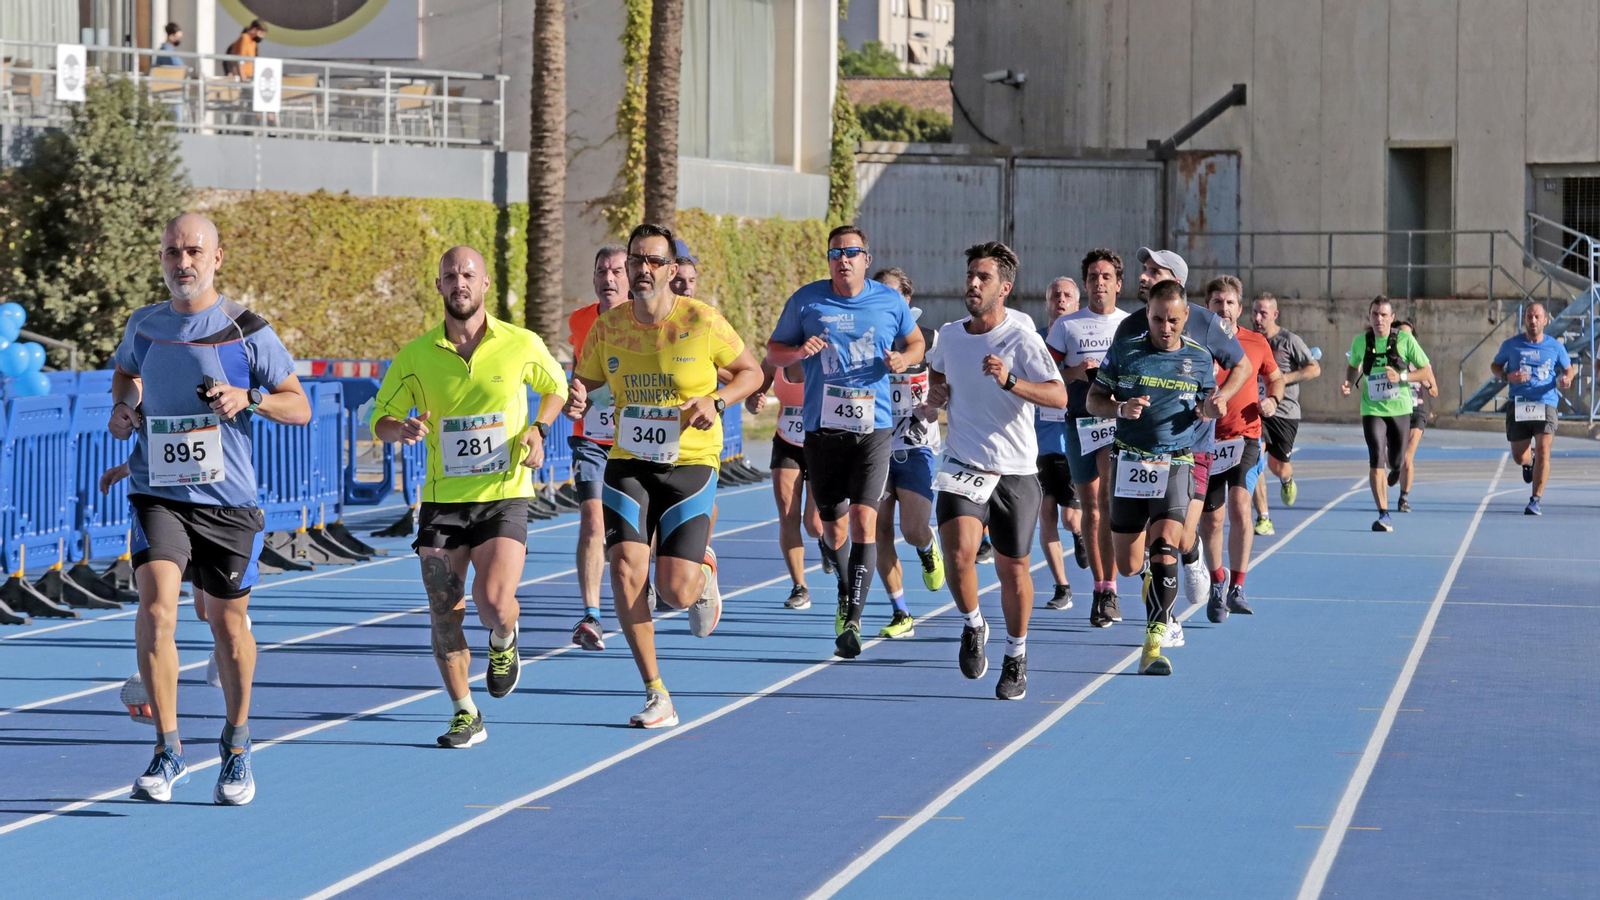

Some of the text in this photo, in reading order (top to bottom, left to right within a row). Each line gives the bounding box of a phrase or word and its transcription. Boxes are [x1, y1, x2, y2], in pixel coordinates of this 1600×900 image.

[837, 313, 854, 321] XLI
[623, 373, 674, 388] TRIDENT
[1375, 382, 1393, 392] 776
[625, 388, 678, 403] RUNNERS
[834, 403, 864, 419] 433
[1525, 405, 1536, 413] 67
[632, 426, 666, 444] 340
[1091, 426, 1117, 442] 968
[163, 441, 206, 464] 895
[456, 436, 493, 457] 281
[952, 471, 985, 488] 476
[1129, 468, 1158, 484] 286
